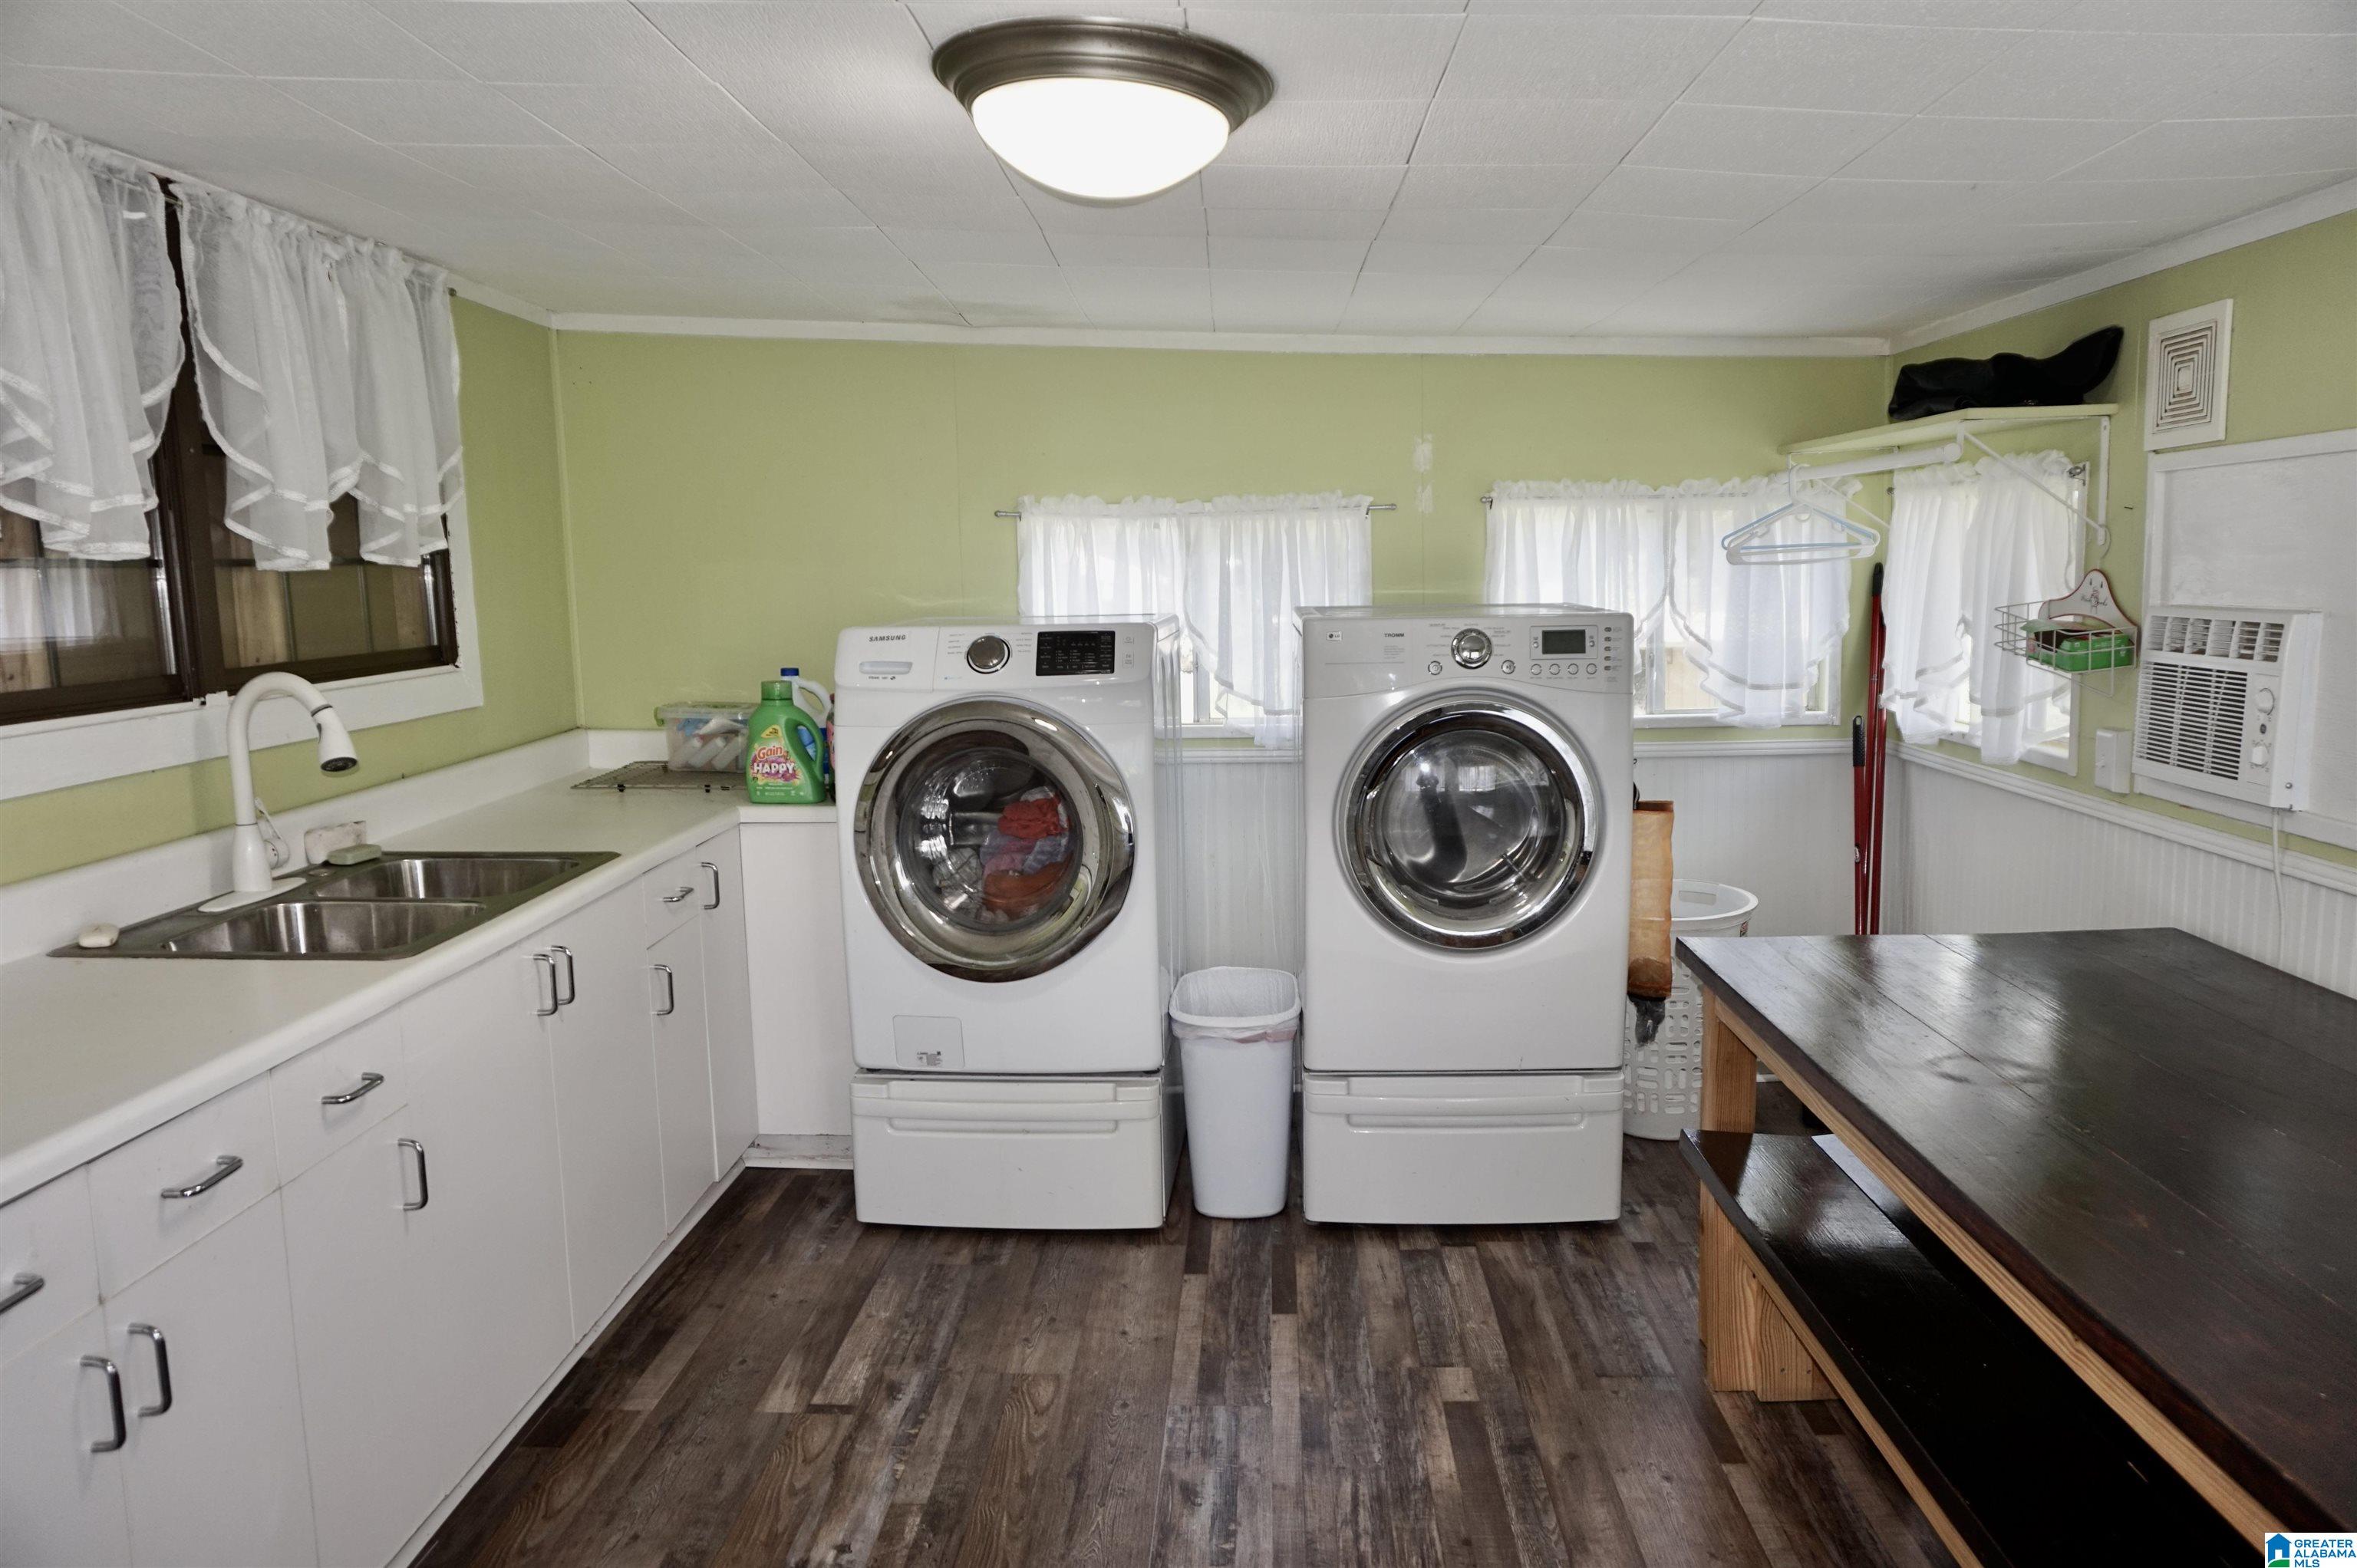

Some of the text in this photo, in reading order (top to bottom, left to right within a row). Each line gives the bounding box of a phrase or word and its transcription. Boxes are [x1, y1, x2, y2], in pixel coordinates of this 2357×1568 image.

[869, 634, 906, 642] SAMSUNG
[757, 745, 783, 760] Gain
[753, 763, 795, 774] HAPPY
